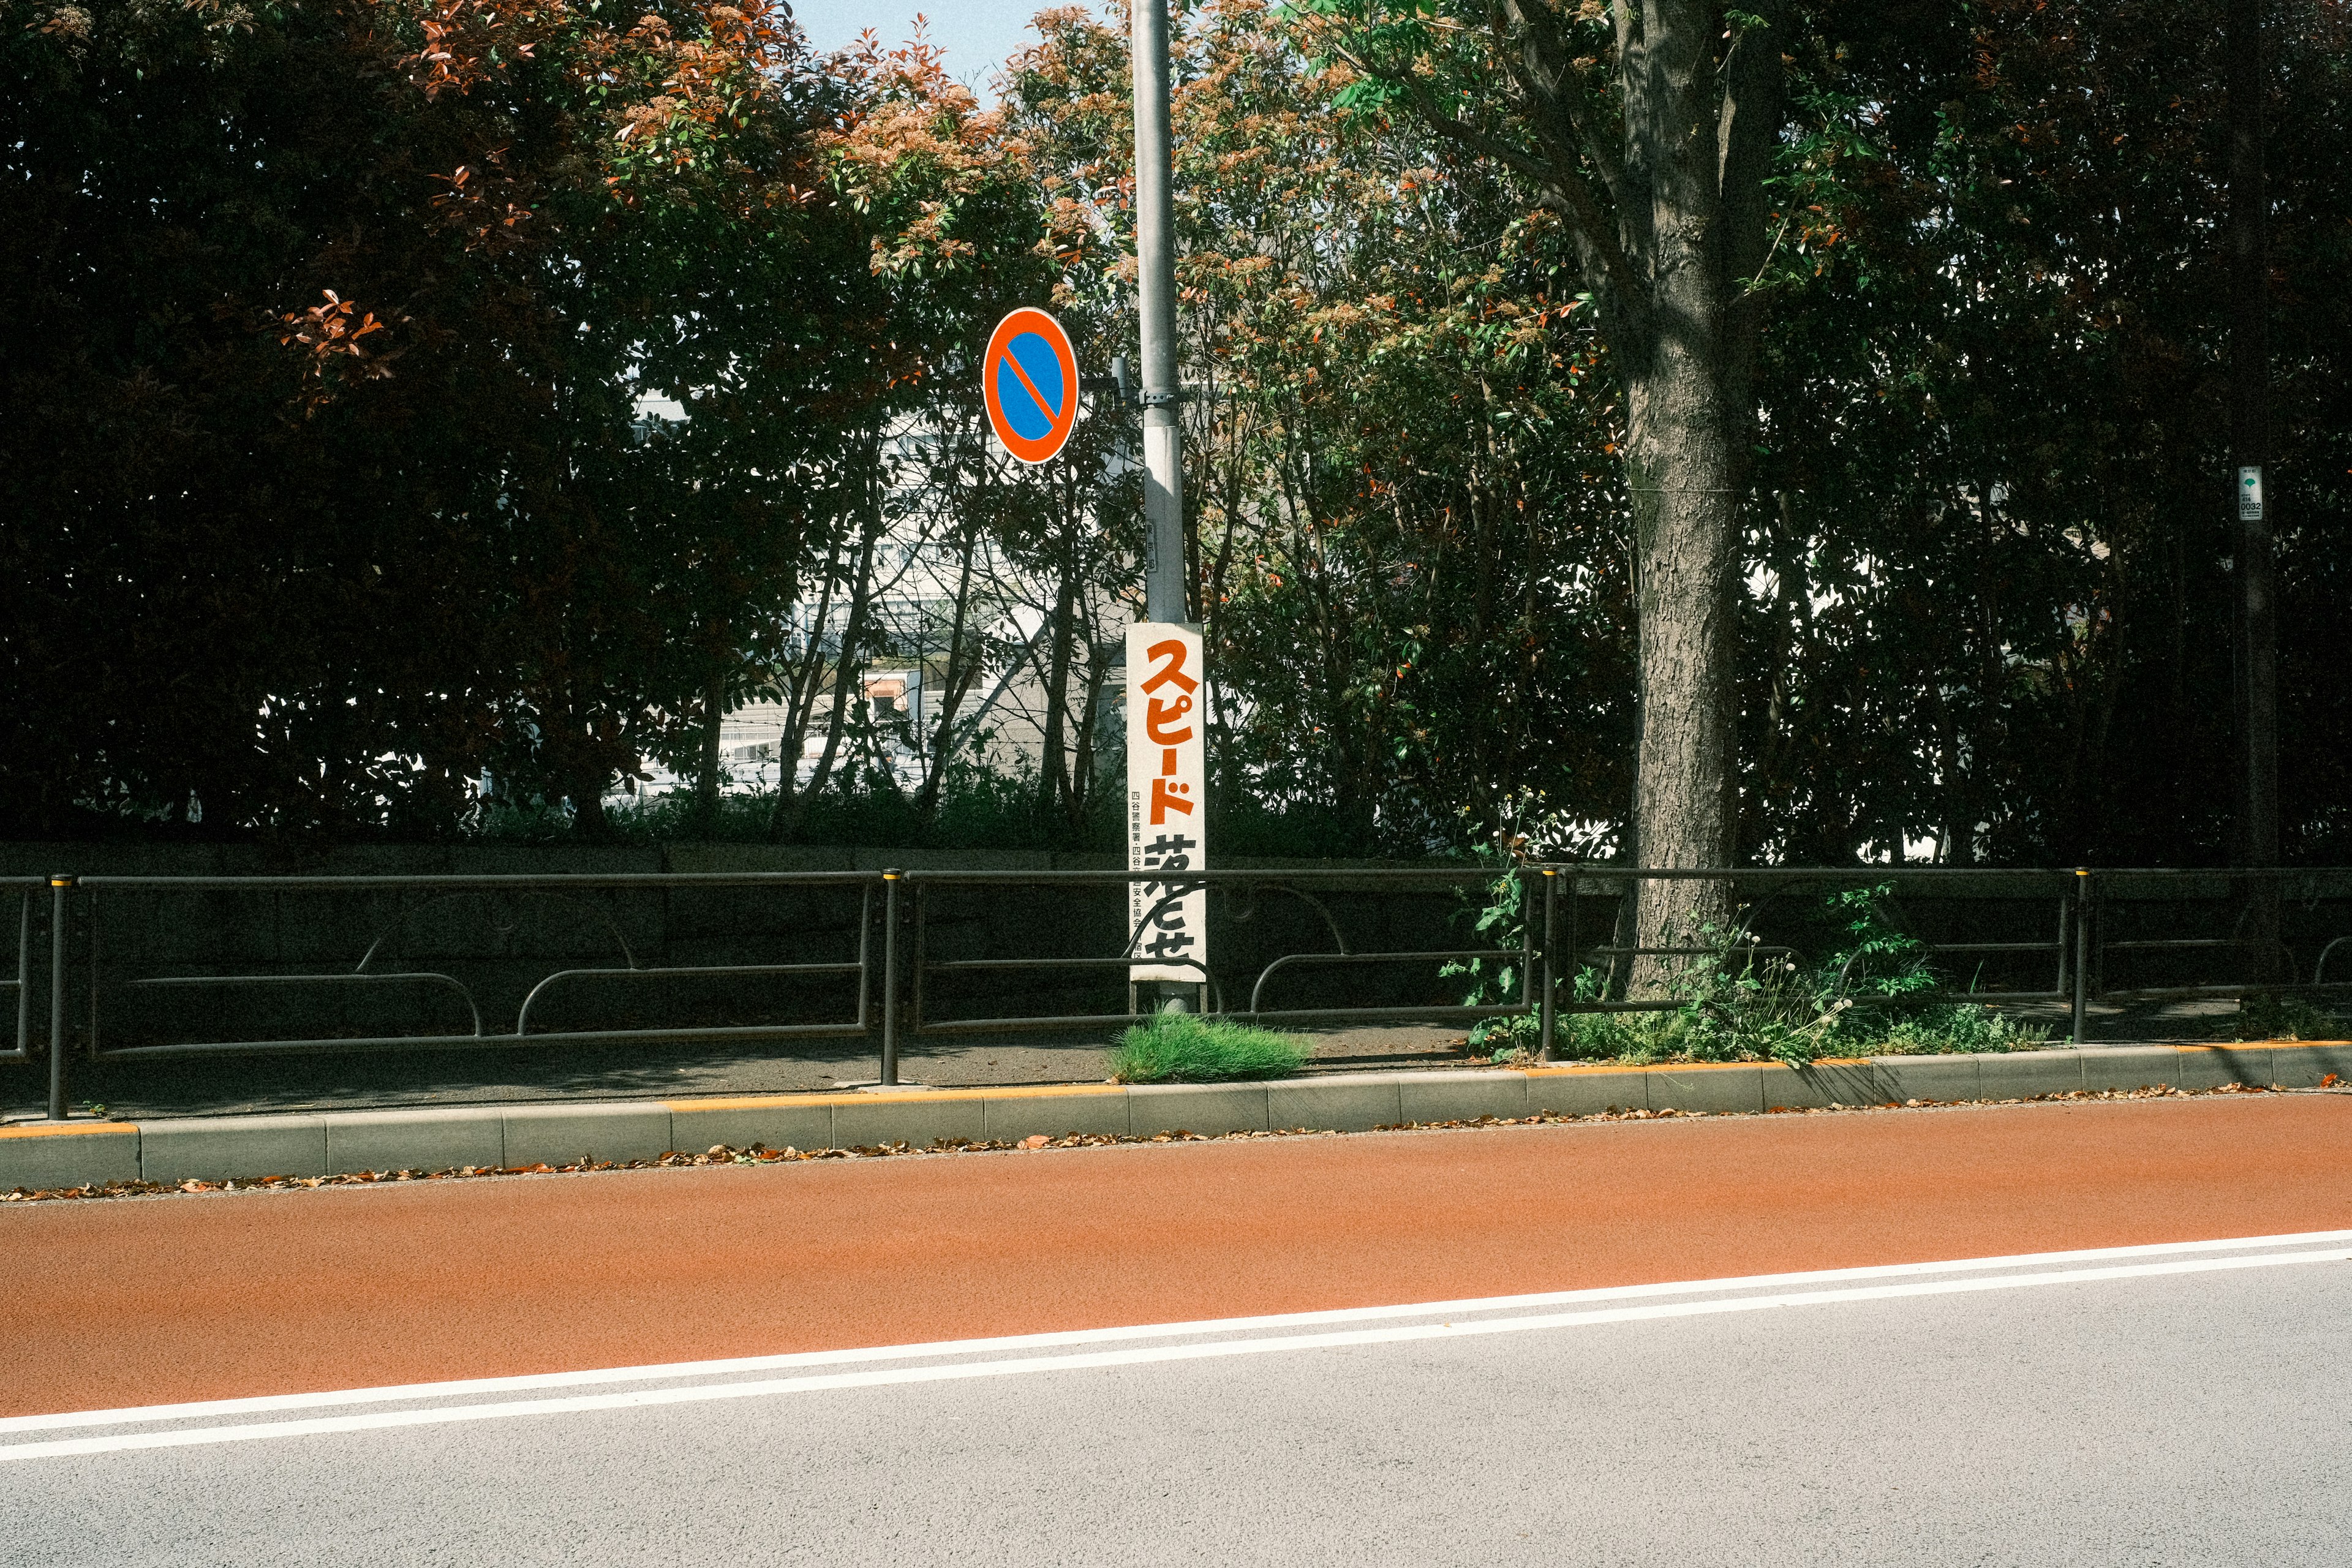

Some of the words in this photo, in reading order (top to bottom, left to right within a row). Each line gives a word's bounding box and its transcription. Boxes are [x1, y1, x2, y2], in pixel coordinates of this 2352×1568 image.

[1140, 639, 1199, 966] スピード落とせ
